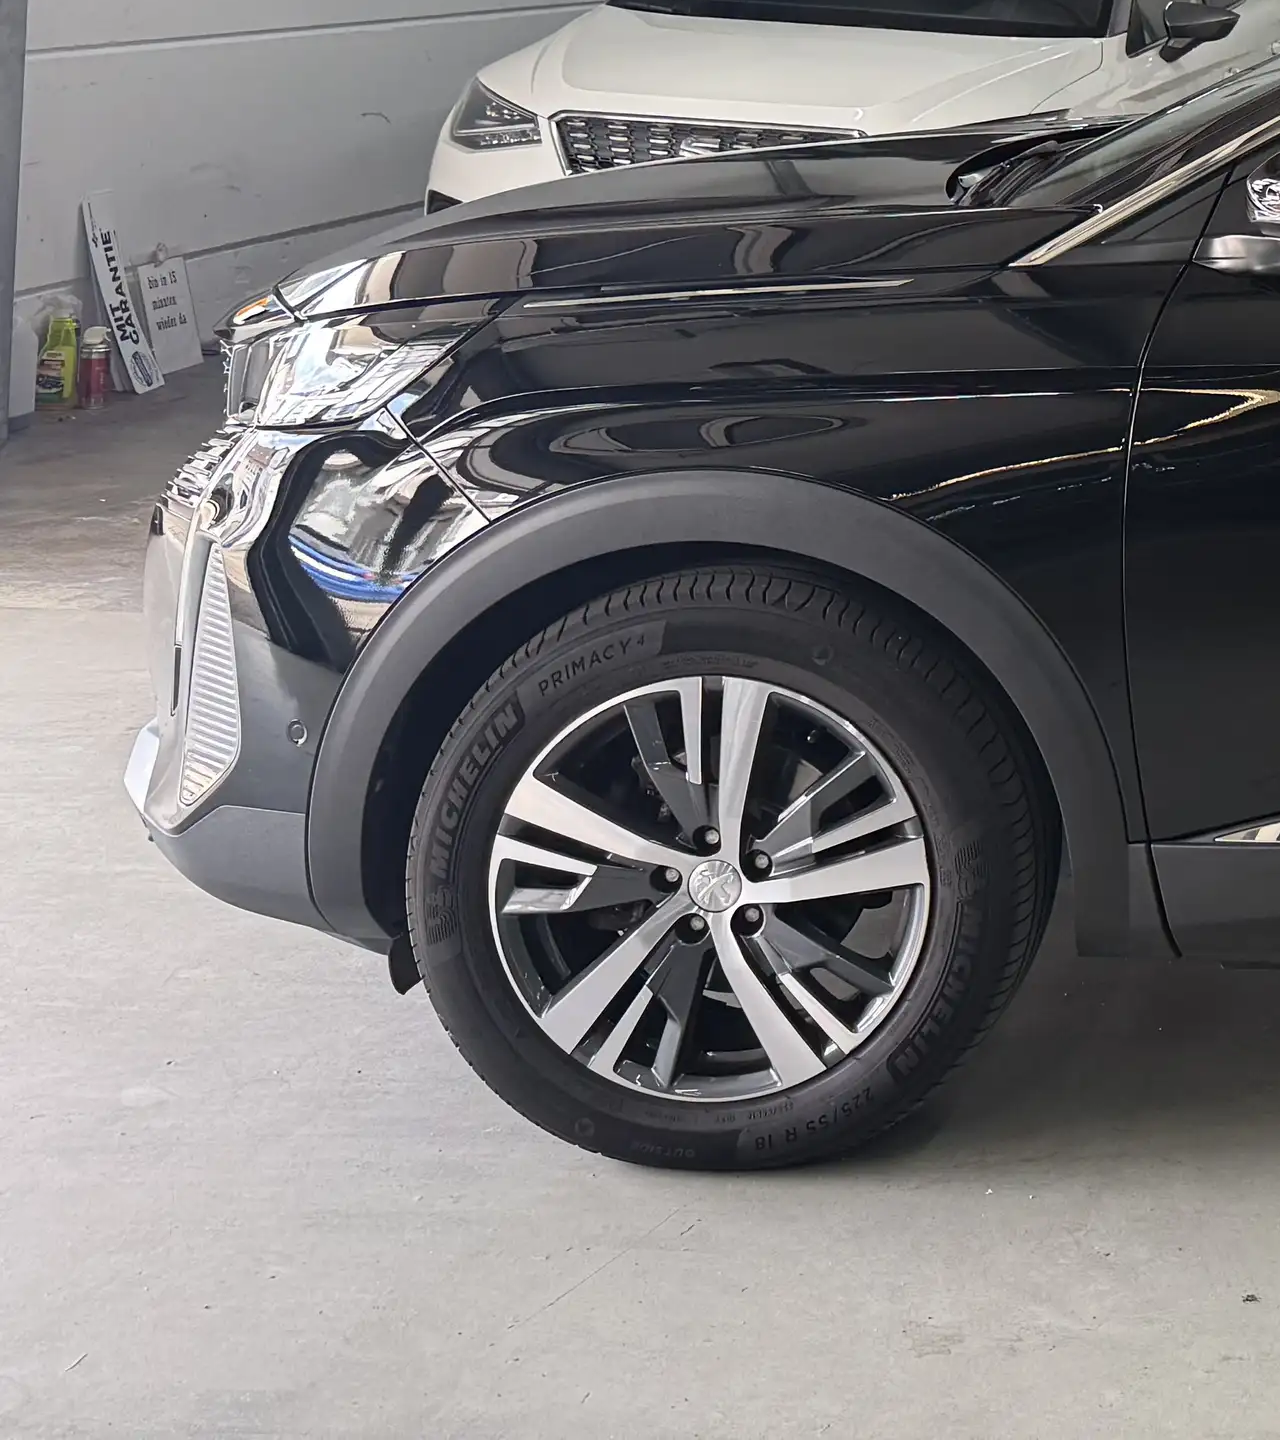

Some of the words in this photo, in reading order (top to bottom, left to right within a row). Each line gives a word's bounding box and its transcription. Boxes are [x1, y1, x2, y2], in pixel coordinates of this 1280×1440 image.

[101, 230, 140, 345] GARANTIE
[110, 303, 130, 342] MIT
[538, 639, 632, 697] PRIMACY
[636, 634, 646, 647] 4
[430, 694, 522, 880] MICHELIN
[806, 1086, 873, 1134] 225/55
[754, 1132, 773, 1151] 18
[785, 1126, 799, 1143] R
